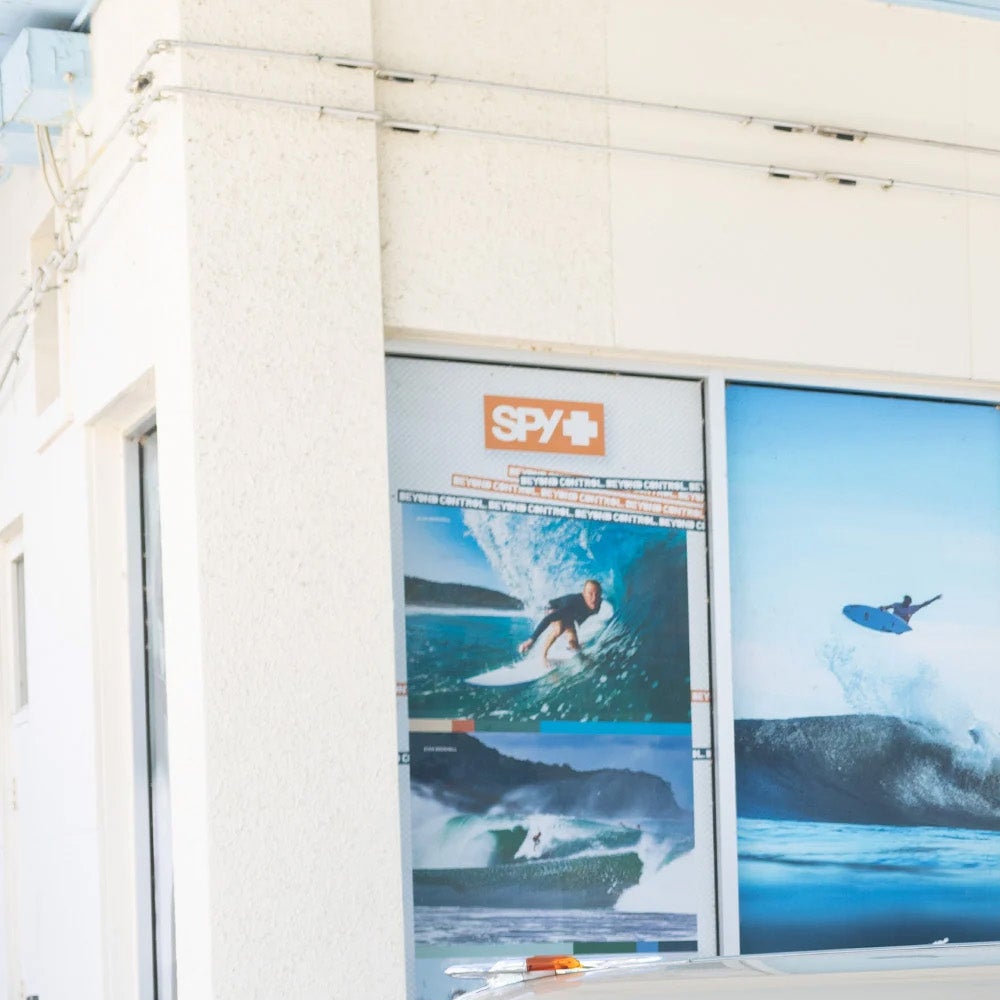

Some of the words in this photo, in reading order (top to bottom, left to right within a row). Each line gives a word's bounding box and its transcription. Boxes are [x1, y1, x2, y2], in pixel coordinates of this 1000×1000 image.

[453, 475, 491, 489] BEYOND
[521, 476, 558, 487] BEYOND
[606, 479, 642, 490] BEYOND
[400, 491, 438, 504] BEYOND
[488, 500, 527, 512] BEYOND
[575, 509, 612, 521] BEYOND
[659, 517, 695, 530] BEYOND
